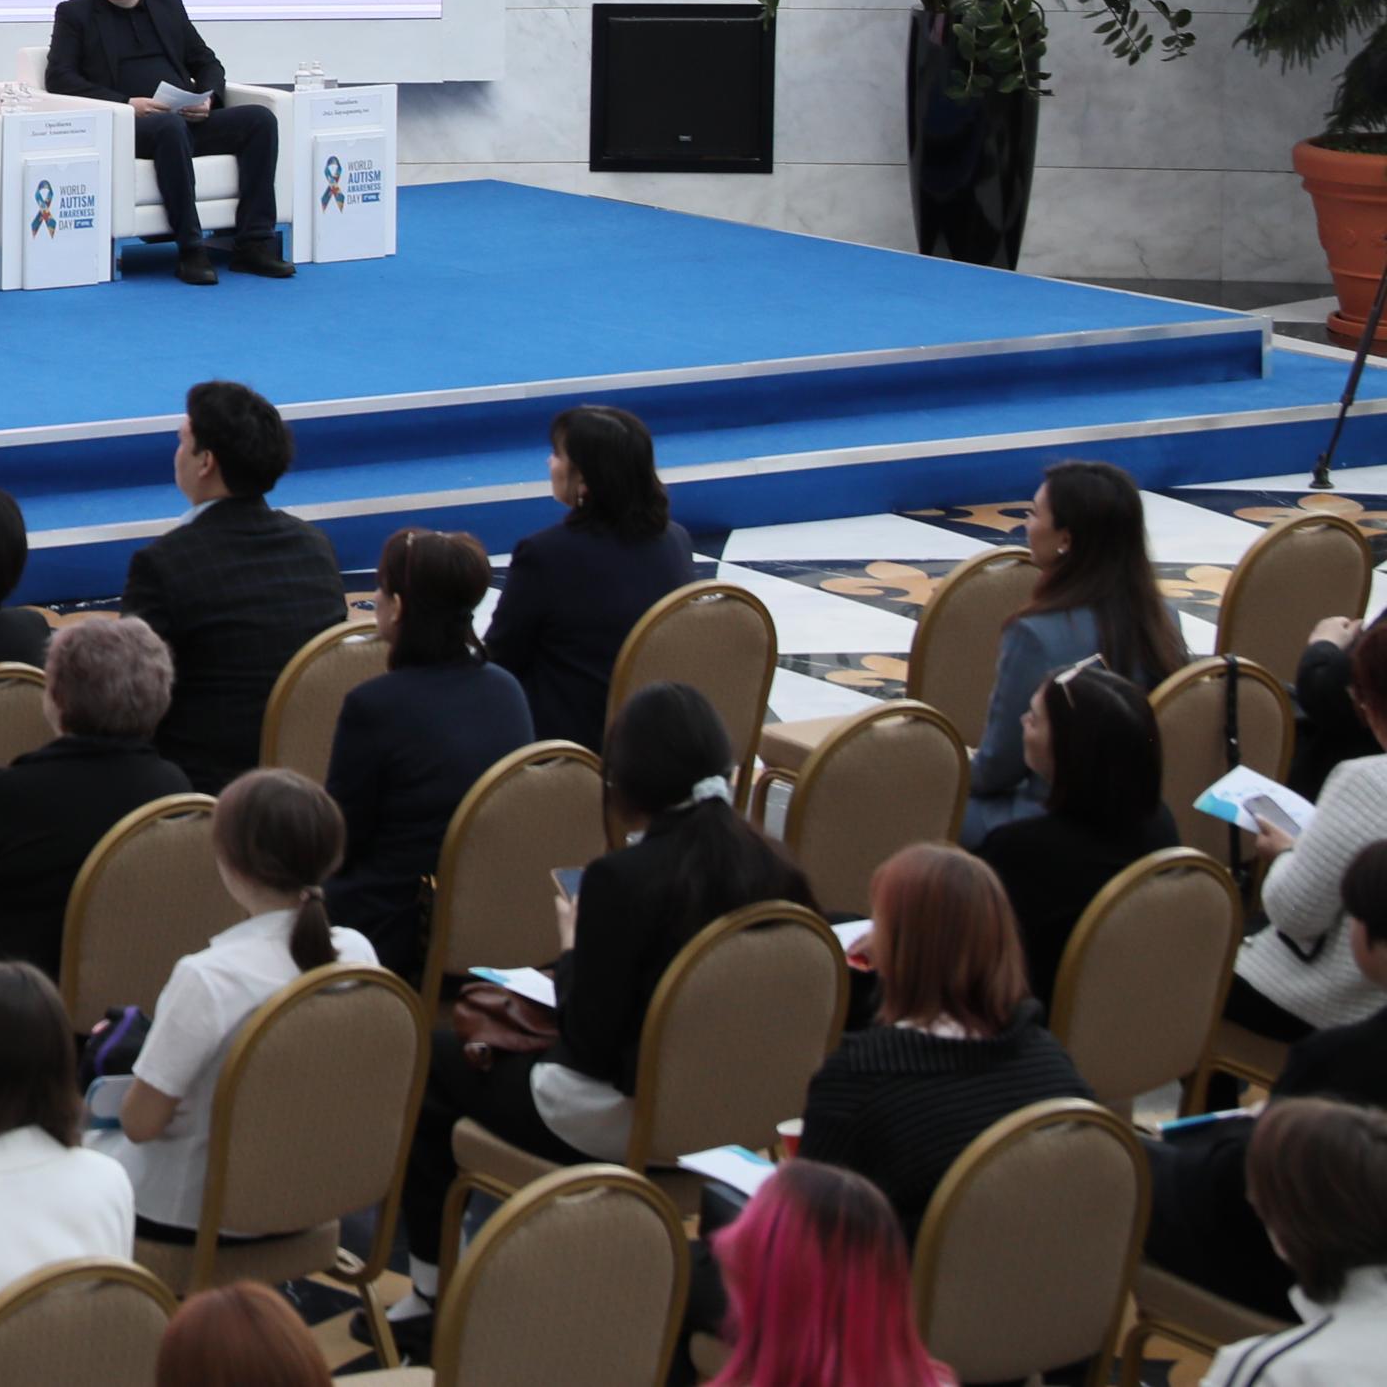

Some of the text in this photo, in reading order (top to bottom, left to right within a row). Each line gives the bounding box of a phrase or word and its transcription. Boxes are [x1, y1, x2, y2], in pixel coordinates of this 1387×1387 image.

[347, 160, 373, 171] WORLD
[348, 170, 381, 184] AUTISM
[59, 184, 86, 195] WORLD
[60, 195, 95, 209] AUTISM
[59, 219, 73, 230] DAY
